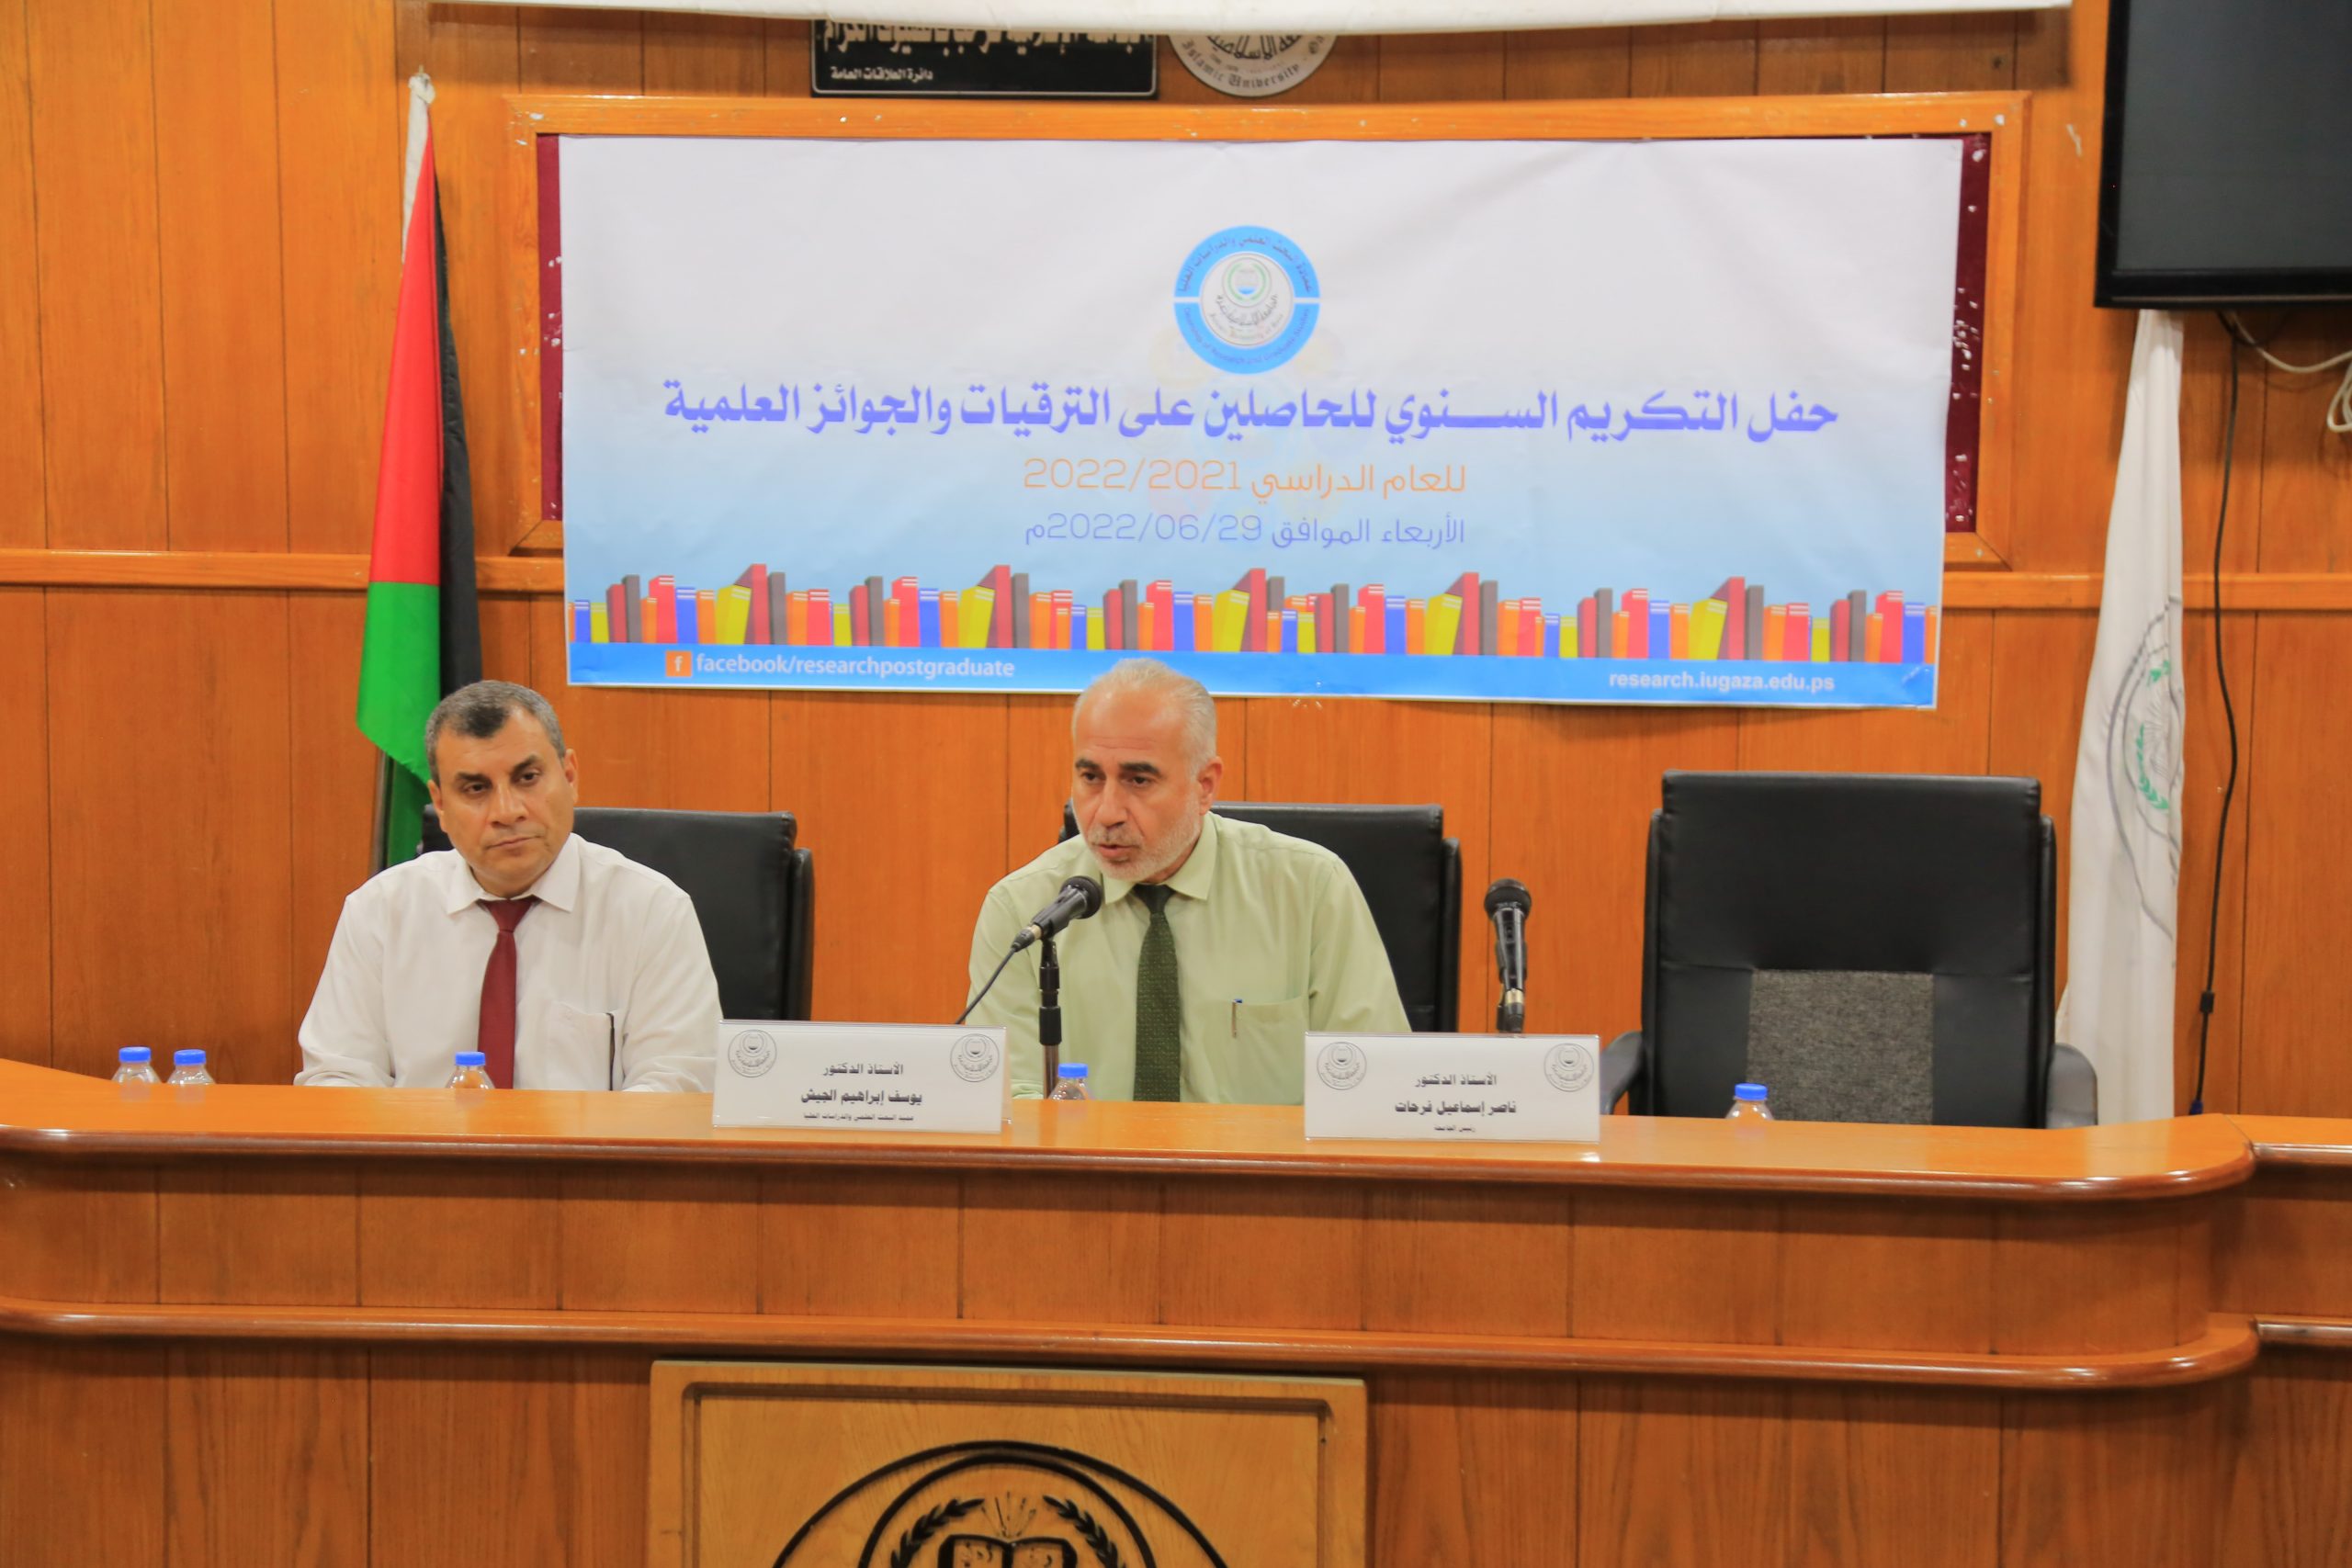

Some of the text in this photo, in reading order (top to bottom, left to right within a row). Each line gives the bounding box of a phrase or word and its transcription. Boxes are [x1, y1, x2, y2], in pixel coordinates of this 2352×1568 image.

[830, 65, 933, 84] دائرة العلاقات العامة
[1228, 63, 1300, 89] University
[662, 379, 1838, 445] حفل التكريم السنوي للحاصلين على الترقيات والجوائز العلمية
[1023, 457, 1467, 504] للعام الدراسي 2022/2021
[1271, 513, 1370, 548] الموافق
[1381, 513, 1464, 546] الأربعاء
[695, 653, 1015, 681] facebook/researchpostgraduate
[1609, 671, 1836, 694] research.iugaza.edu.ps
[823, 1062, 864, 1077] الدكتور
[1415, 1073, 1456, 1088] الدكتور
[800, 1089, 922, 1106] يوسف إبراهيم الجيش
[1395, 1100, 1517, 1117] ناصر إسماعيل فرحات
